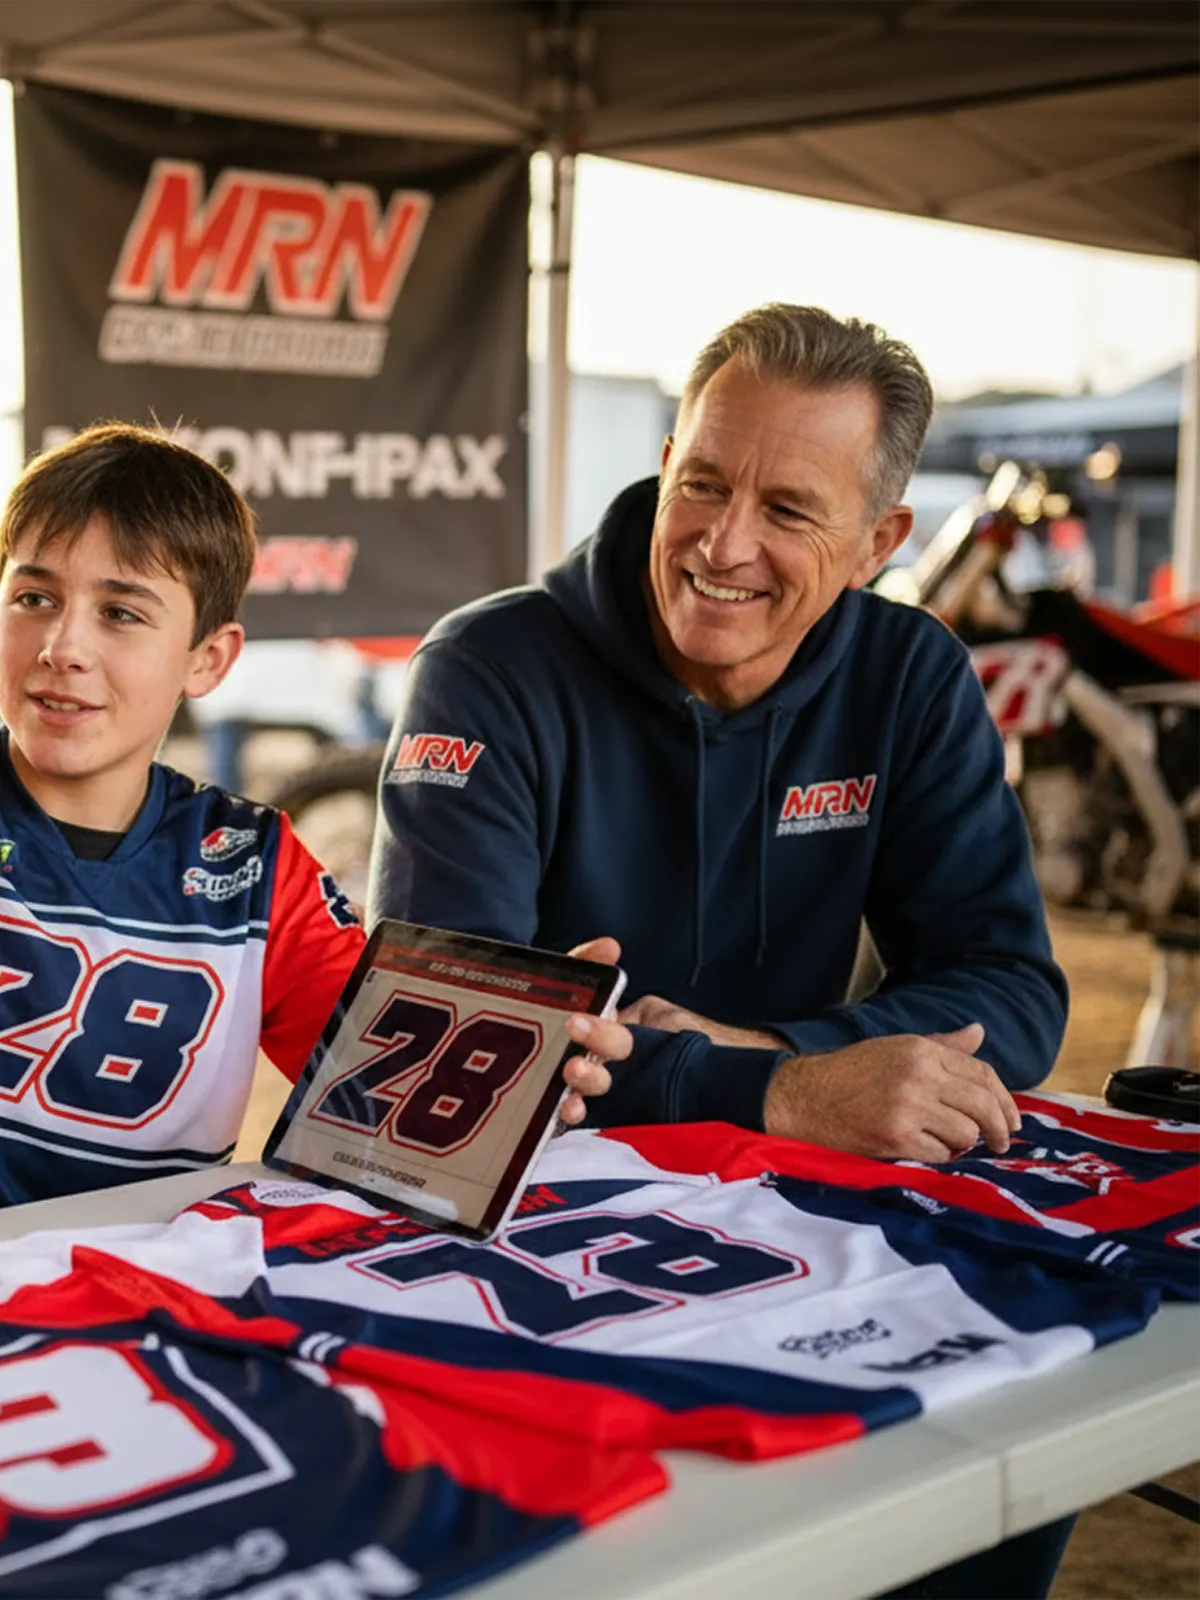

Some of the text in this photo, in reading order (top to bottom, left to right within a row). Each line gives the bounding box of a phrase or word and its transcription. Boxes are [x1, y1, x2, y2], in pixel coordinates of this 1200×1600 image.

[108, 157, 435, 321] MRN
[393, 732, 486, 775] MRN
[779, 773, 877, 820] MRN
[307, 988, 543, 1158] 28
